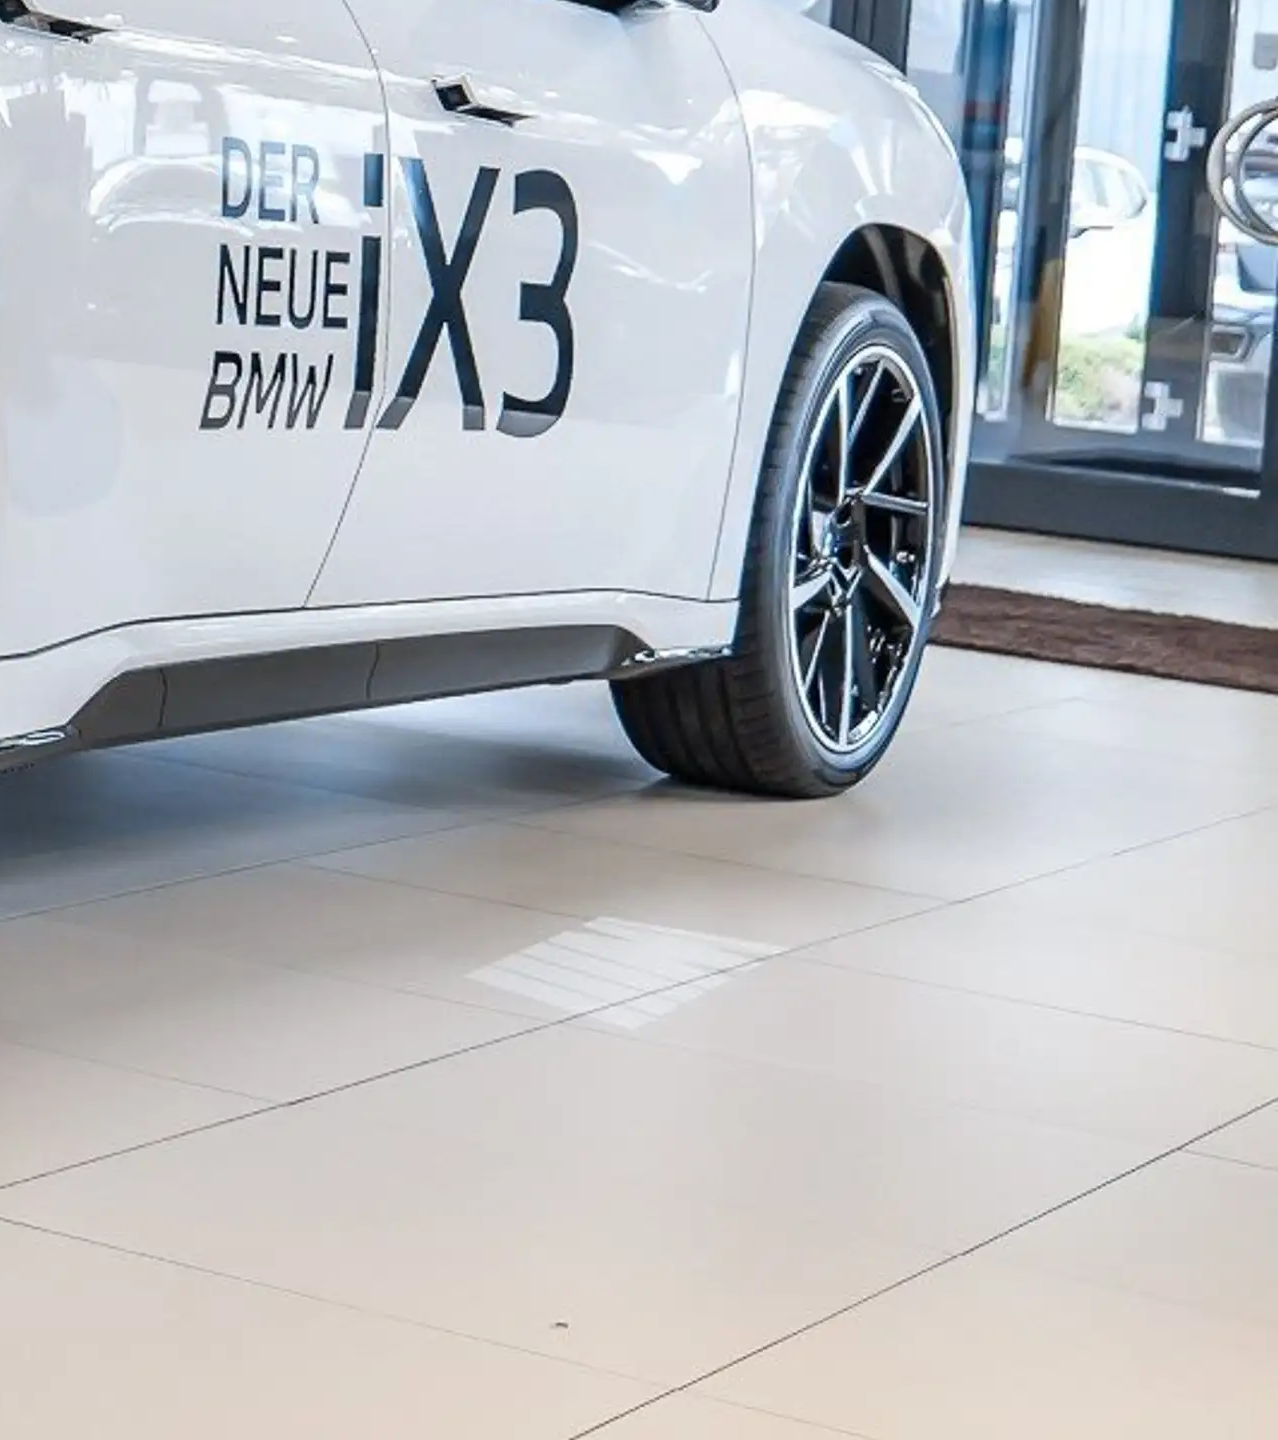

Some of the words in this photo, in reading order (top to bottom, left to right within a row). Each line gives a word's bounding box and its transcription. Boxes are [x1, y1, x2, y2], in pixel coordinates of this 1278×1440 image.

[221, 136, 320, 224] DER
[216, 243, 350, 330] NEUE
[343, 152, 579, 438] iX3
[199, 350, 335, 430] BMW
